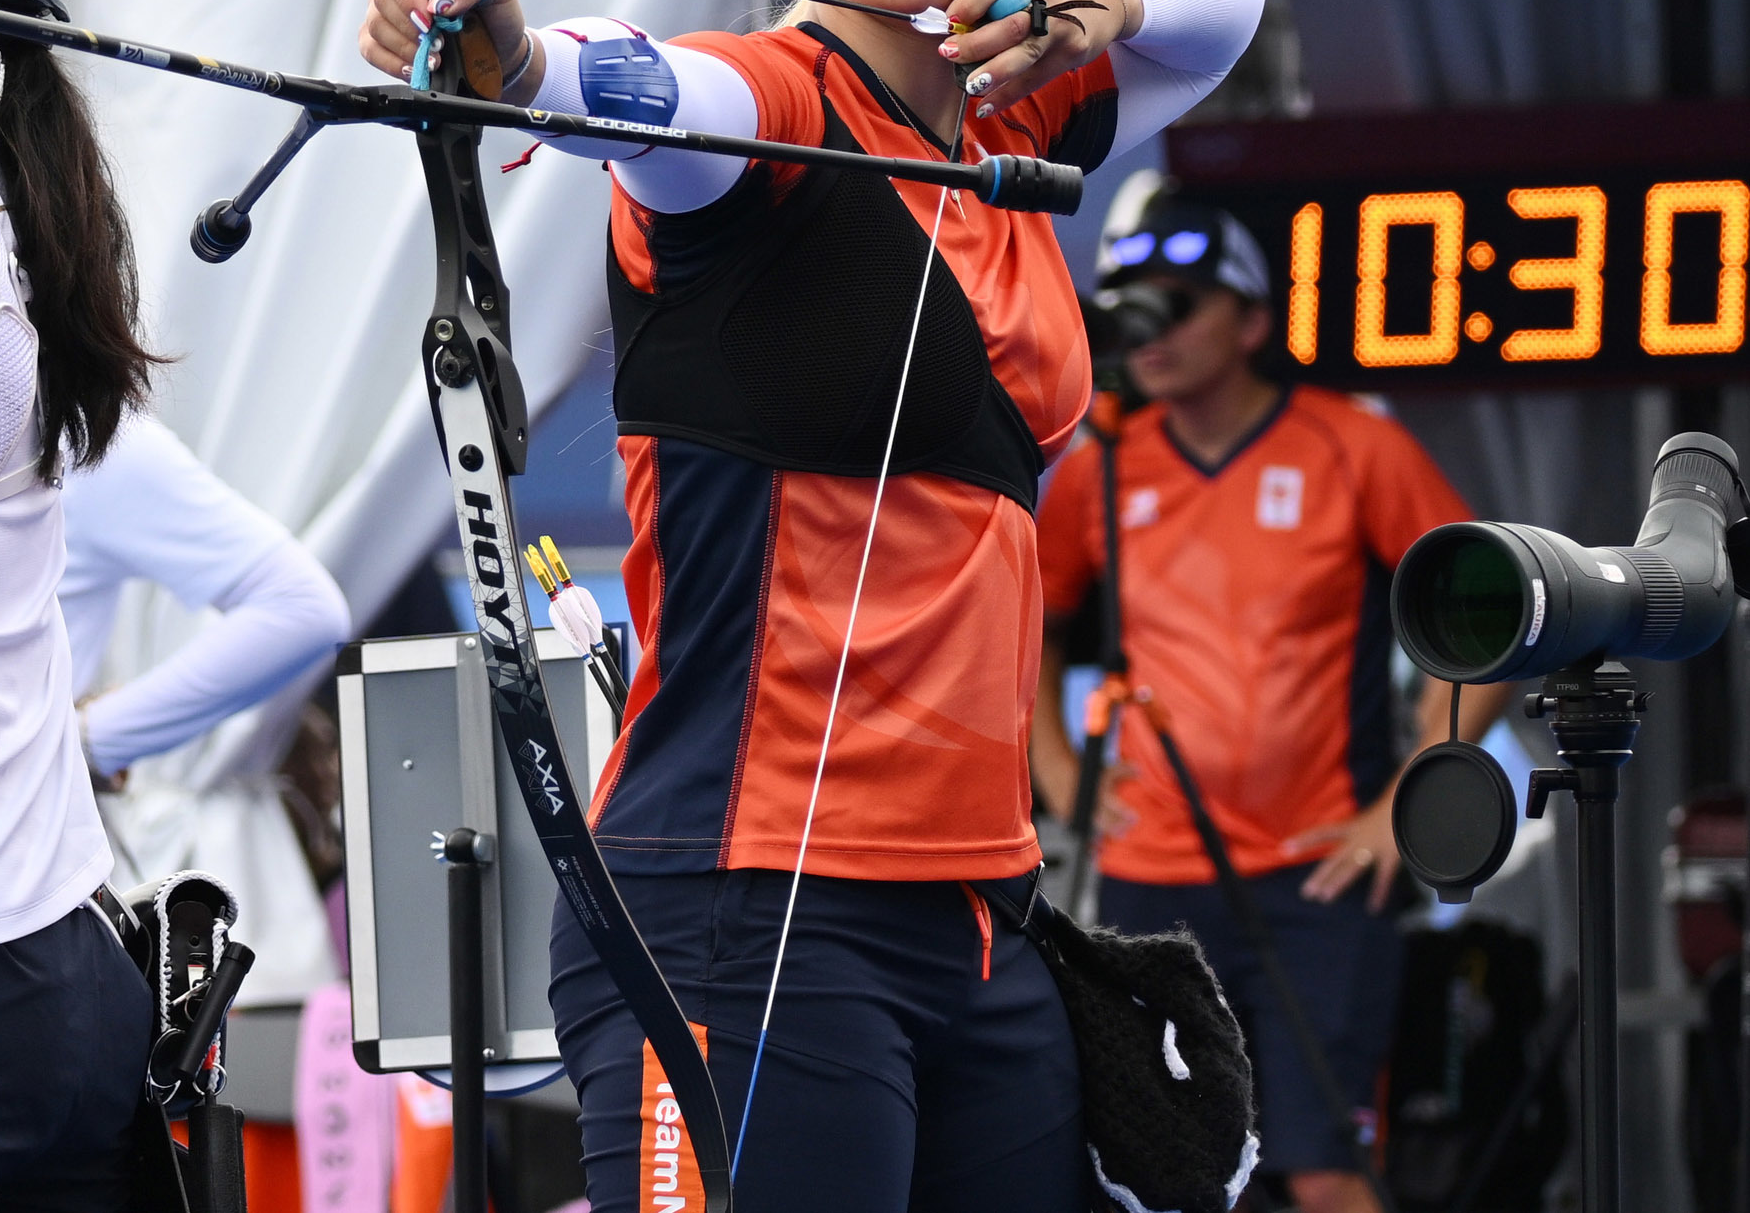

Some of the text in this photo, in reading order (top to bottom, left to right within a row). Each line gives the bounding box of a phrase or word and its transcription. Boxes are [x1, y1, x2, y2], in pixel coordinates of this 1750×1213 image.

[586, 116, 687, 139] RAMRODS
[1288, 180, 1750, 367] 10:30
[463, 489, 527, 681] HOYT
[524, 738, 564, 816] AXIA
